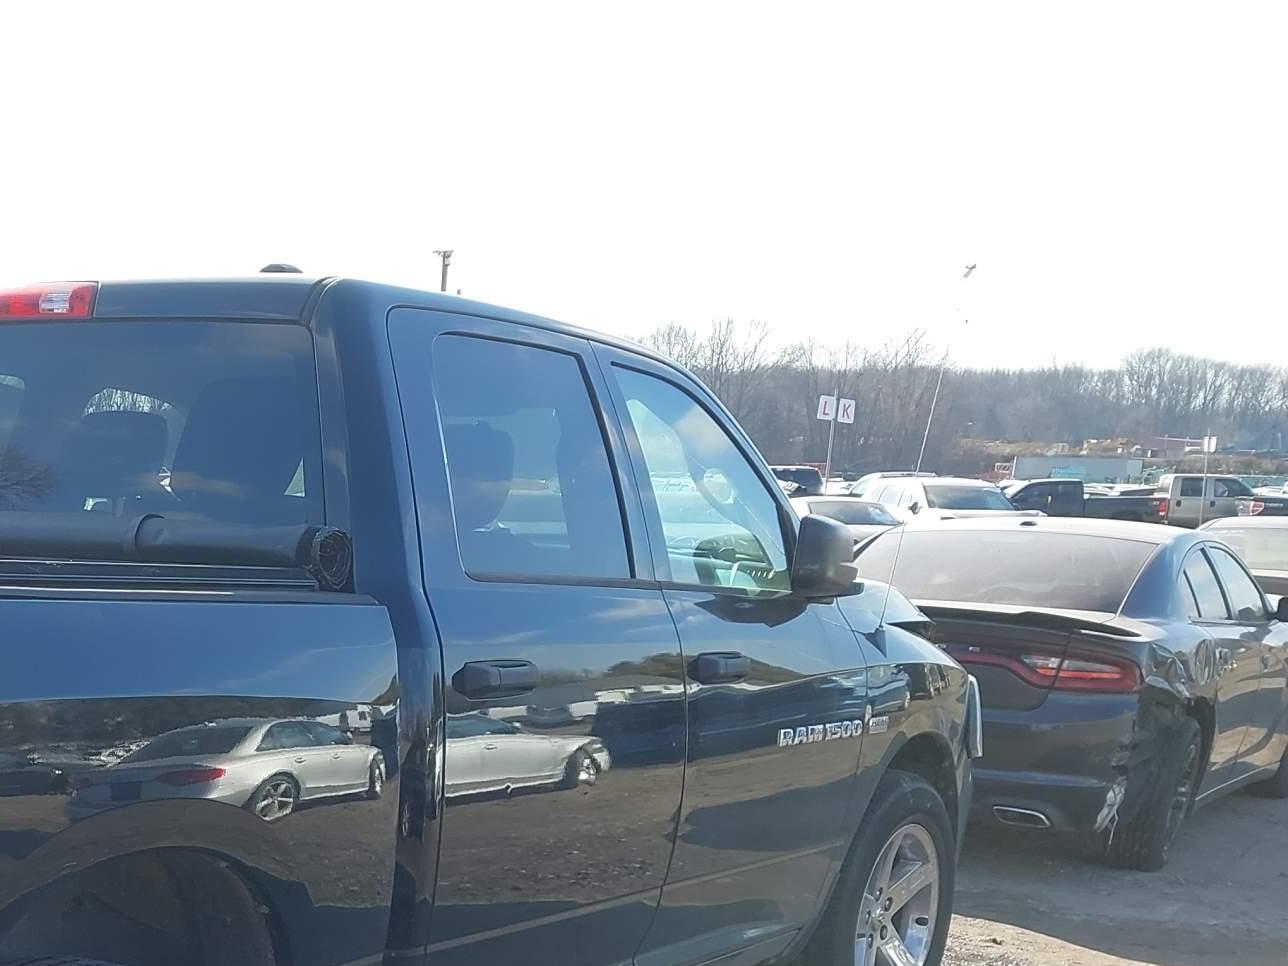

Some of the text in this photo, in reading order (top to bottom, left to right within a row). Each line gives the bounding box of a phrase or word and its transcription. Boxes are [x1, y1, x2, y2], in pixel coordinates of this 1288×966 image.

[822, 399, 830, 416] L
[842, 403, 852, 420] K
[778, 724, 824, 748] RAM
[825, 719, 863, 741] 1500
